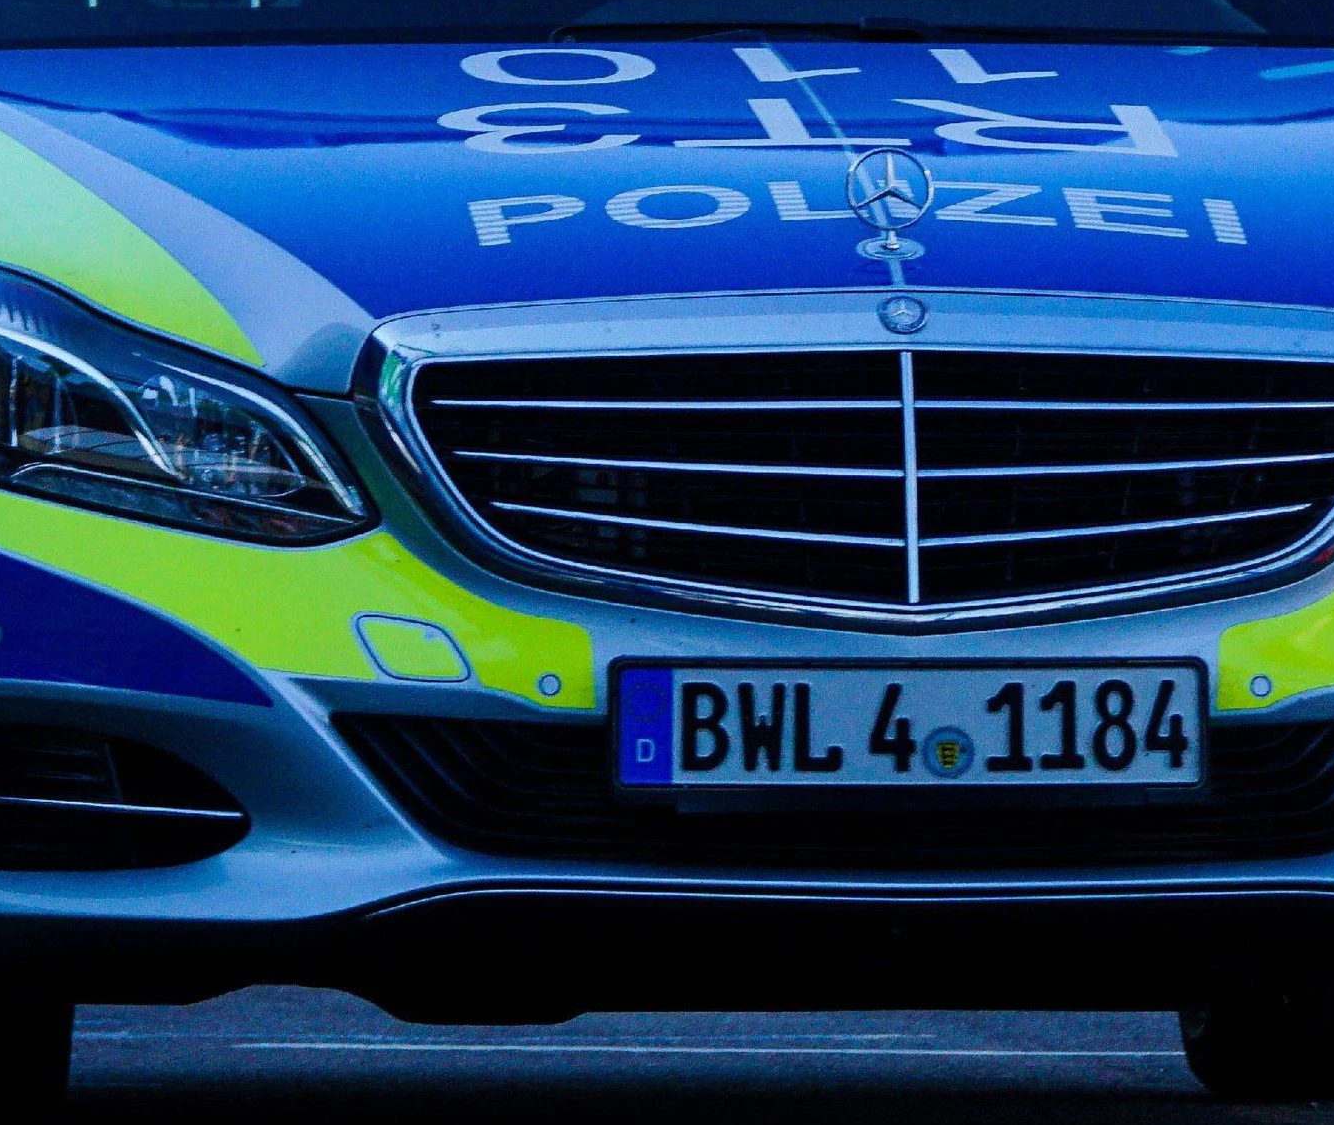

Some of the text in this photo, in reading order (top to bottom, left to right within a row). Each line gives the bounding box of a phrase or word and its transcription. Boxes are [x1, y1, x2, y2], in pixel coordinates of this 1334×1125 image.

[460, 48, 1059, 85] 110
[467, 178, 1247, 246] POLIZEI
[635, 738, 656, 763] D
[680, 679, 1188, 772] BWL 4 1184
